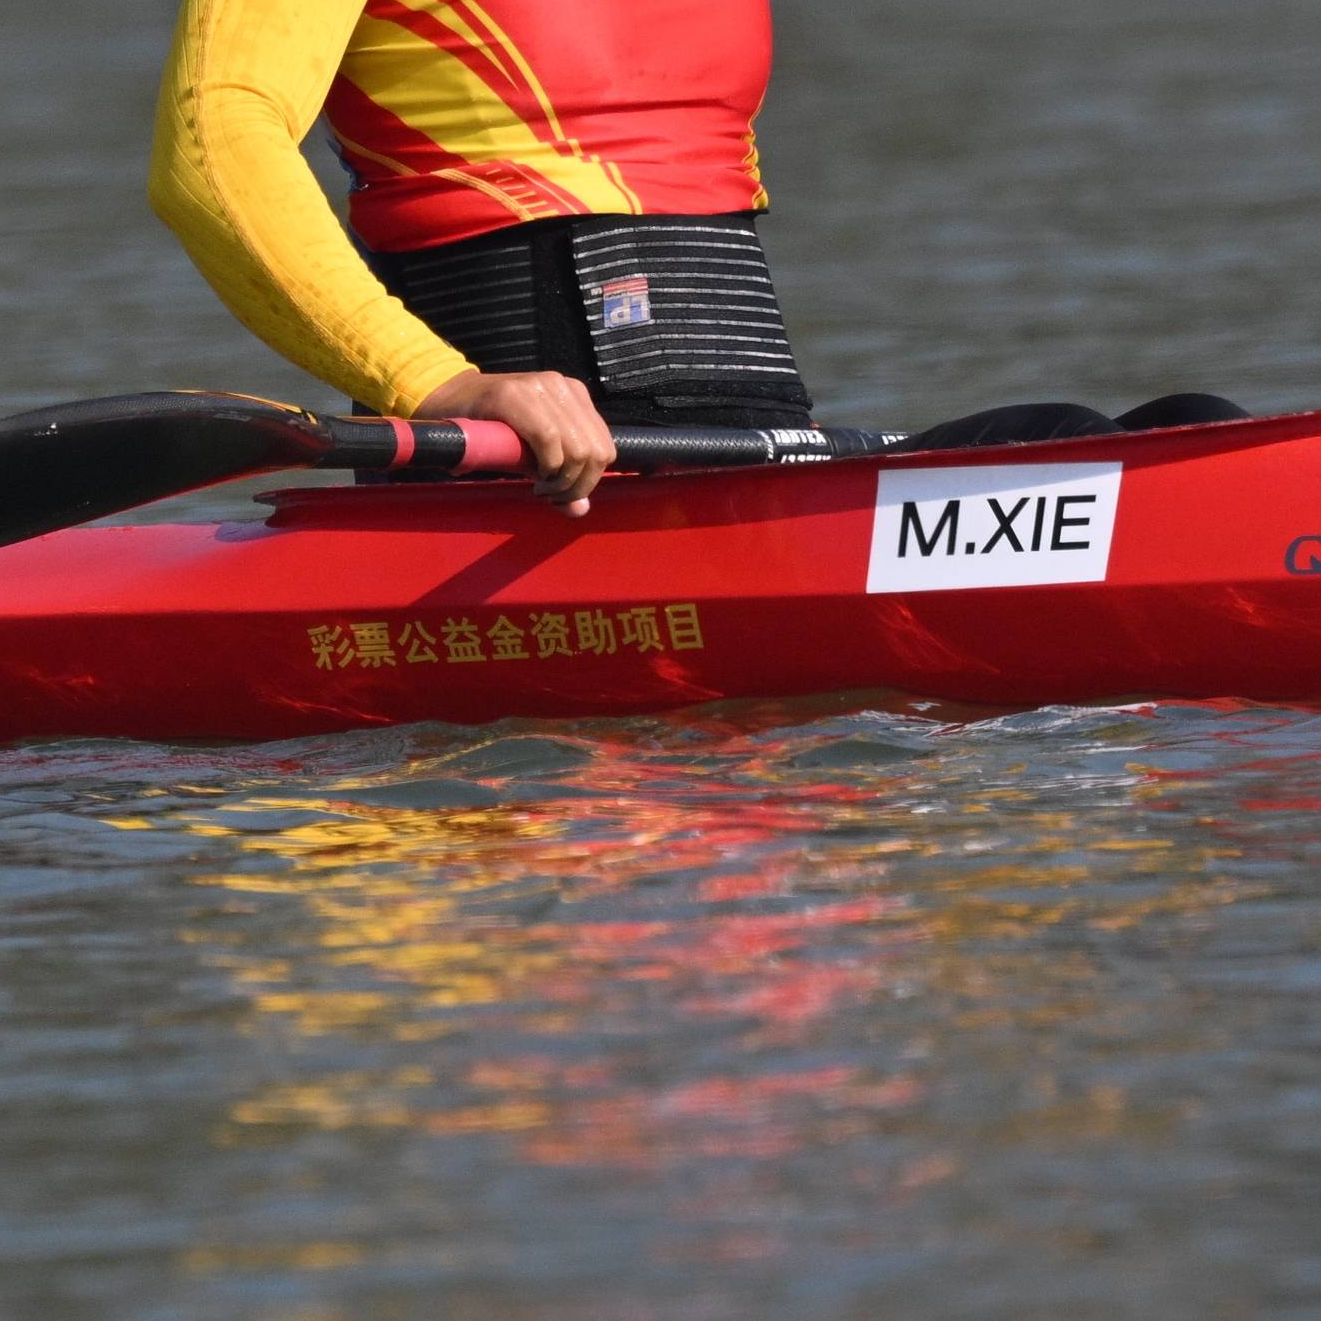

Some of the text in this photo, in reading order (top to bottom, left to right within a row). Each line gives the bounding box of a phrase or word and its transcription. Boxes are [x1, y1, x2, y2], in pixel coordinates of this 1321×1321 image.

[897, 494, 1097, 558] M.XIE
[306, 602, 705, 671] 彩票公益金资助项目
